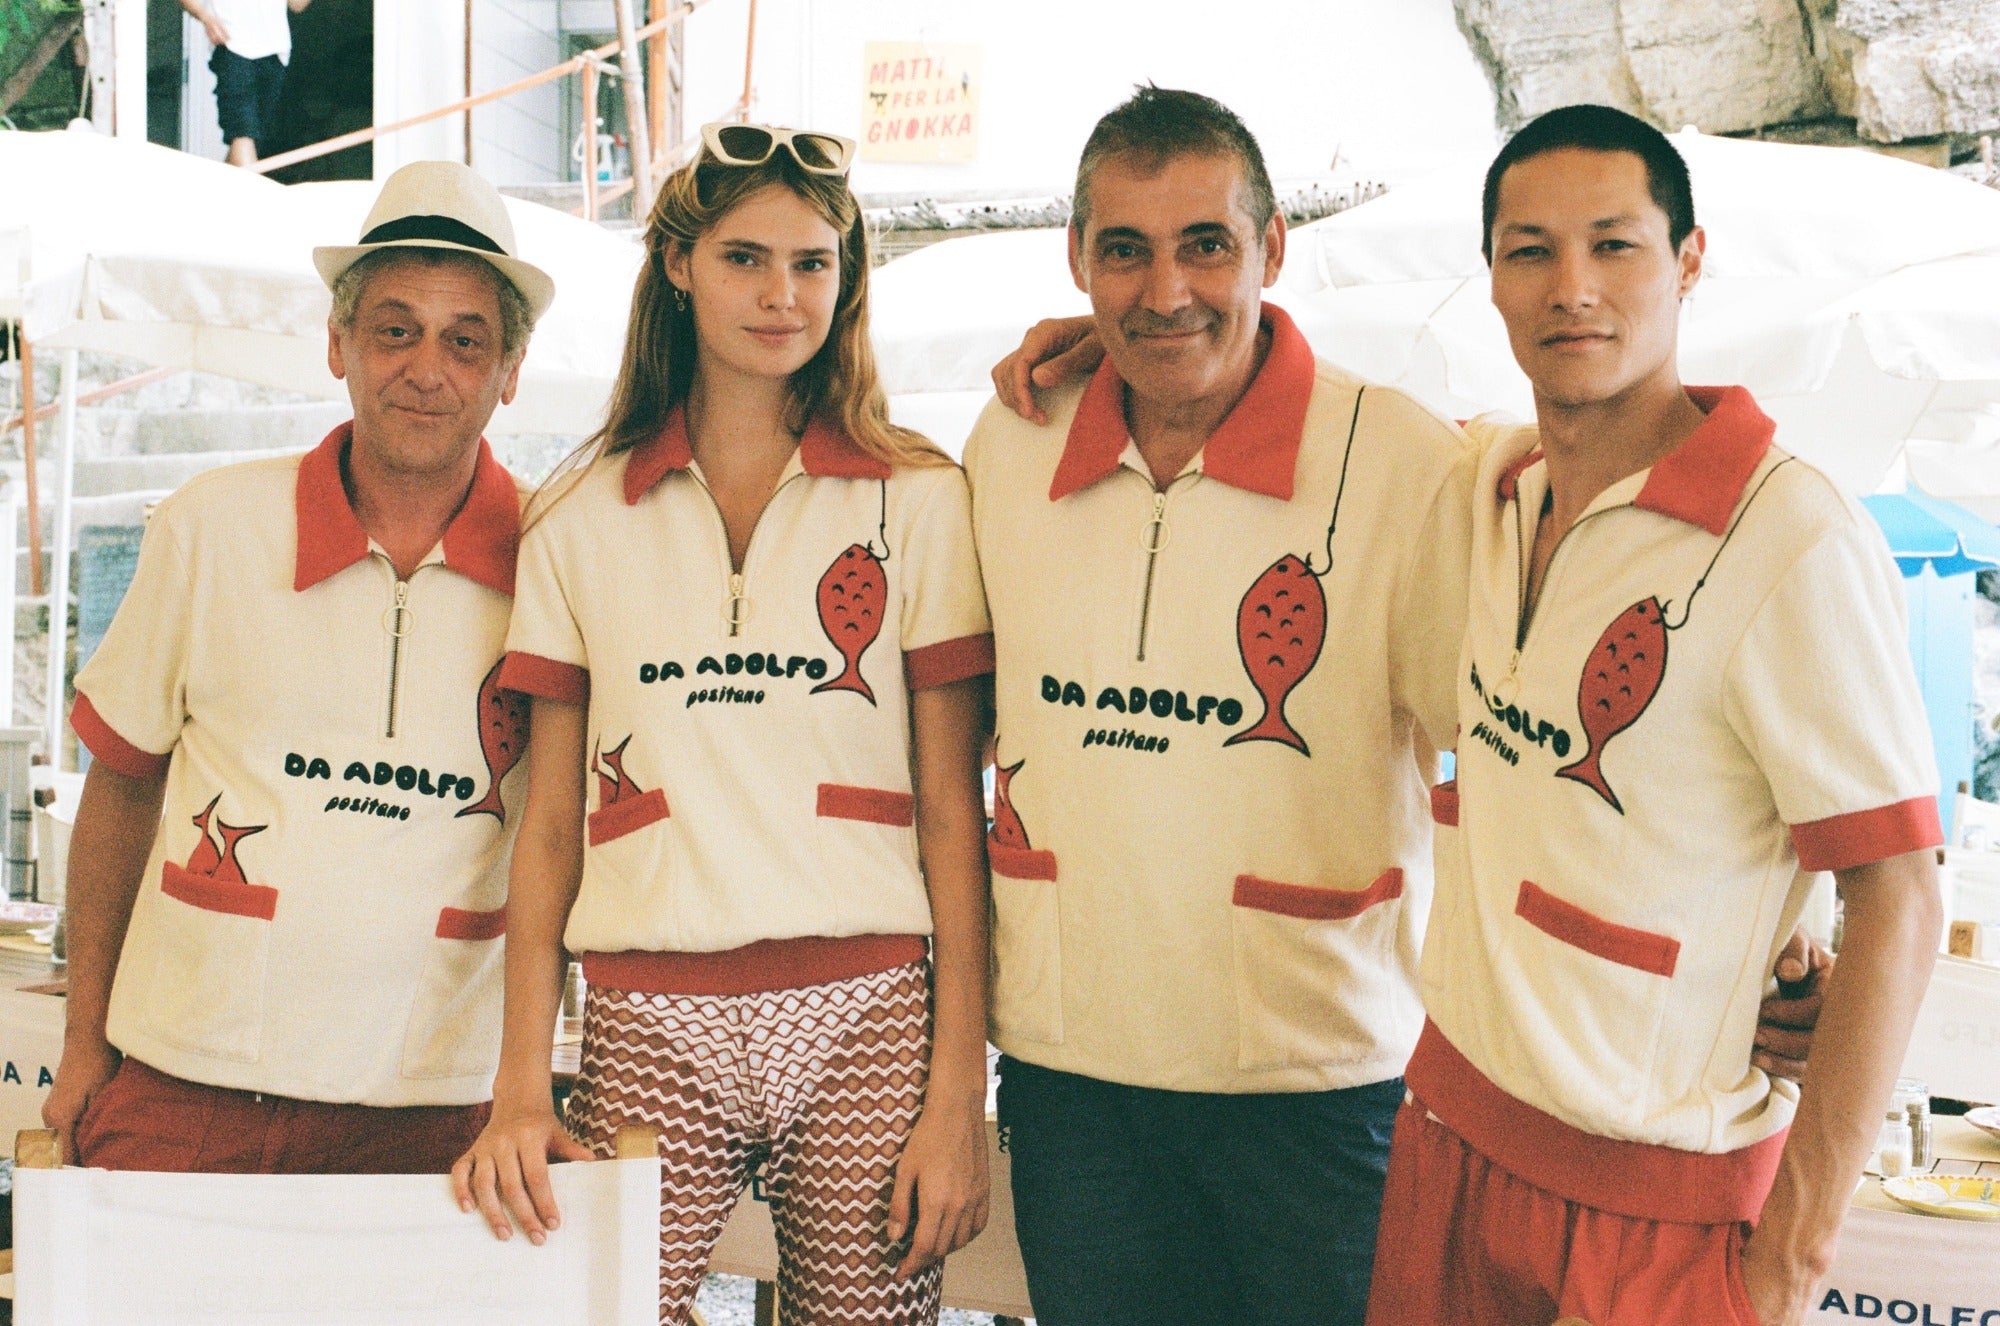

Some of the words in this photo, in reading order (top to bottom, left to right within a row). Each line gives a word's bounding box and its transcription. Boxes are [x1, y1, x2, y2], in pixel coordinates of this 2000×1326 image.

[892, 89, 927, 108] PER
[935, 87, 956, 105] LA
[868, 112, 972, 143] GNOKKA
[639, 662, 685, 684] DA
[696, 652, 828, 680] ADOLFO
[686, 686, 765, 709] positano
[1041, 674, 1086, 708] DA
[1096, 686, 1244, 726] ADOLFO
[1082, 728, 1170, 754] positano
[284, 752, 332, 780] DA
[343, 761, 476, 801] ADOLFO
[324, 796, 411, 821] positano
